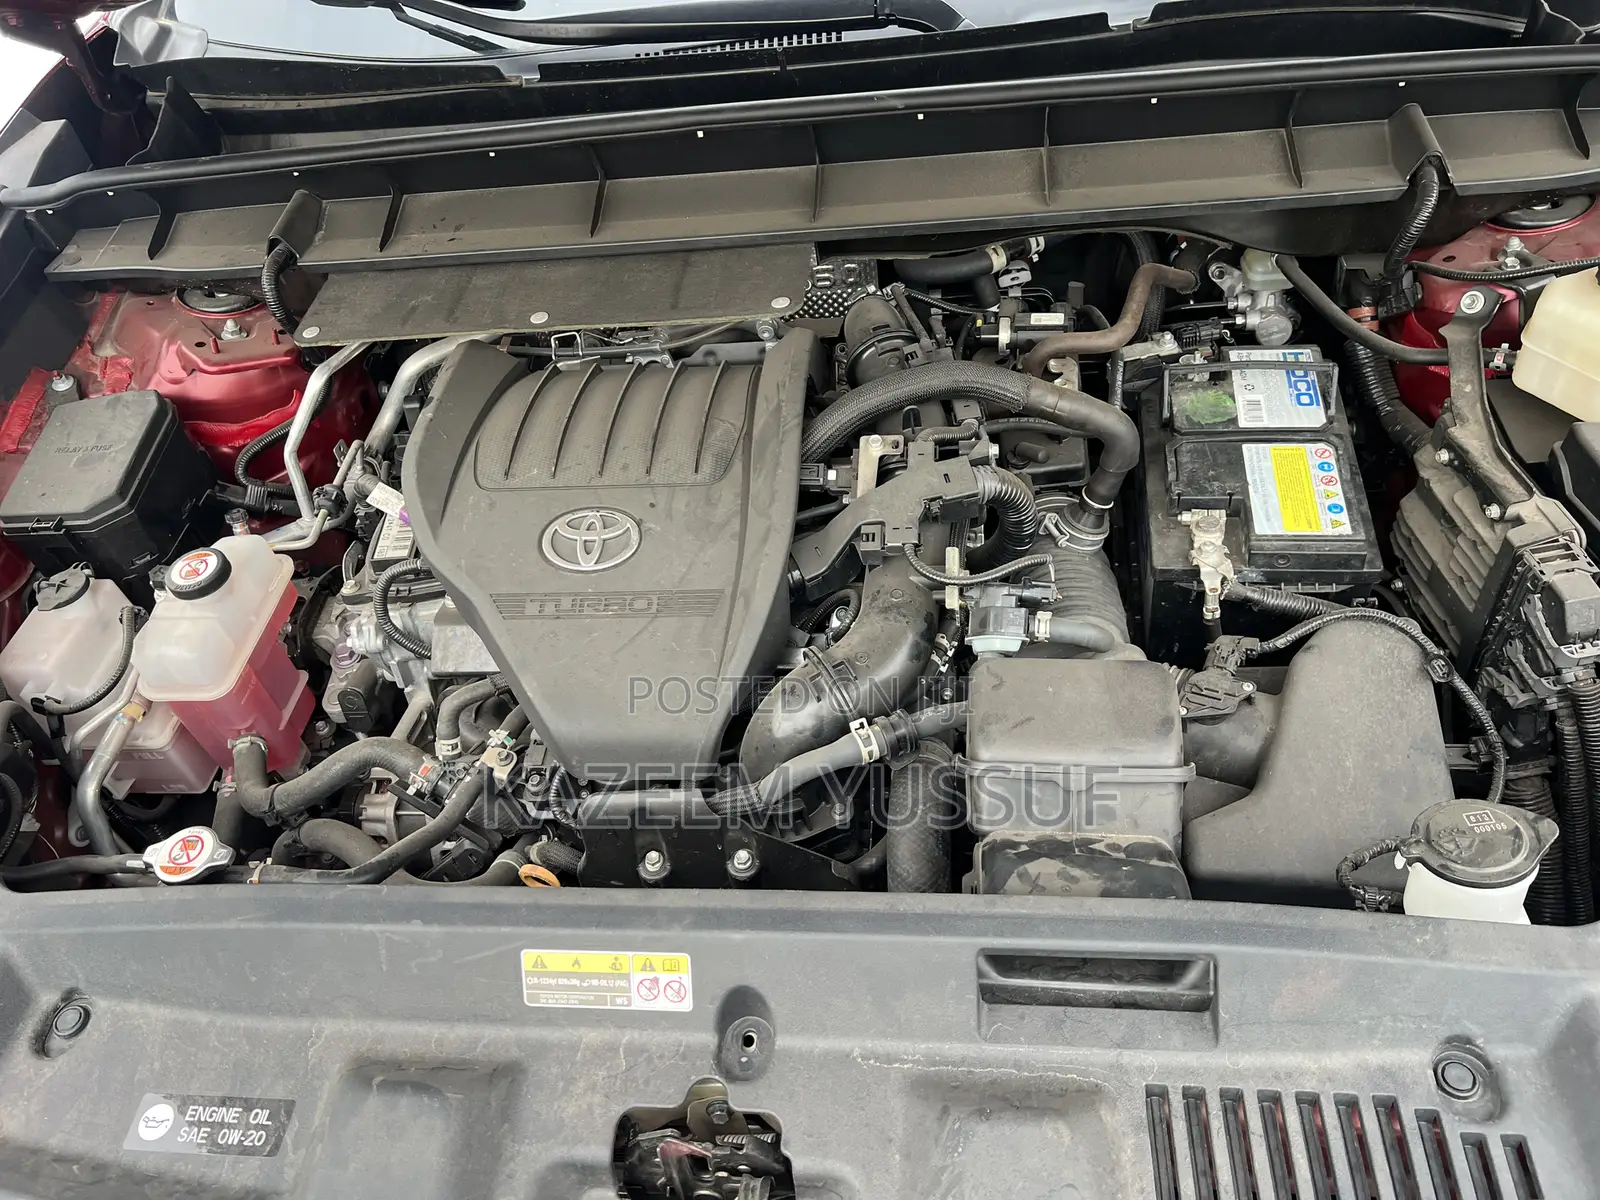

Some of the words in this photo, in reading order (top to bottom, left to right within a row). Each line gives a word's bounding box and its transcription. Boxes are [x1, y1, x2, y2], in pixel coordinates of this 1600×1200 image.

[530, 595, 655, 615] TURBO
[132, 752, 164, 760] FULL
[1473, 822, 1508, 834] 000105
[615, 996, 629, 1005] WS
[185, 1106, 242, 1123] ENGINE
[249, 1109, 272, 1125] OIL
[177, 1127, 211, 1143] SAE
